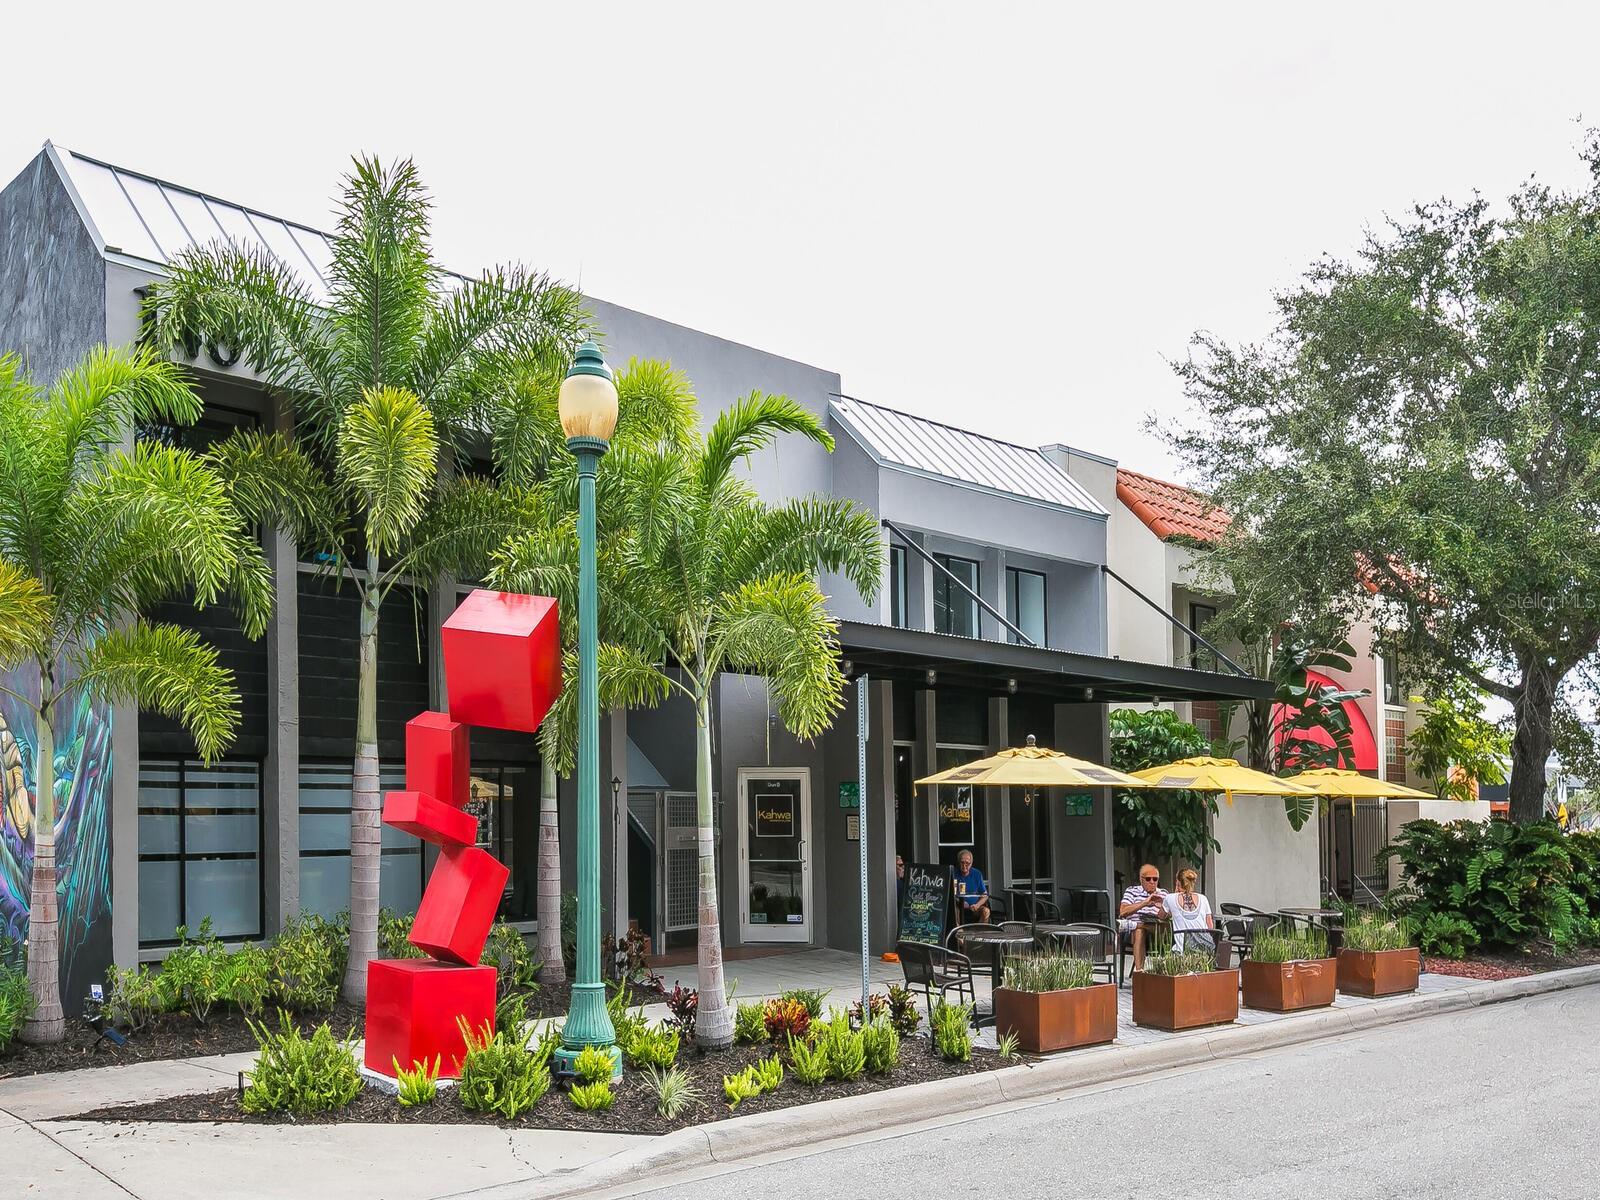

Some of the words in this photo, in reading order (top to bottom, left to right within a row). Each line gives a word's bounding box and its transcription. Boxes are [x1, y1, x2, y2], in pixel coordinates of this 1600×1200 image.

[758, 808, 791, 820] Kahwa
[939, 802, 971, 818] Kahwa
[909, 867, 944, 887] Kahwa
